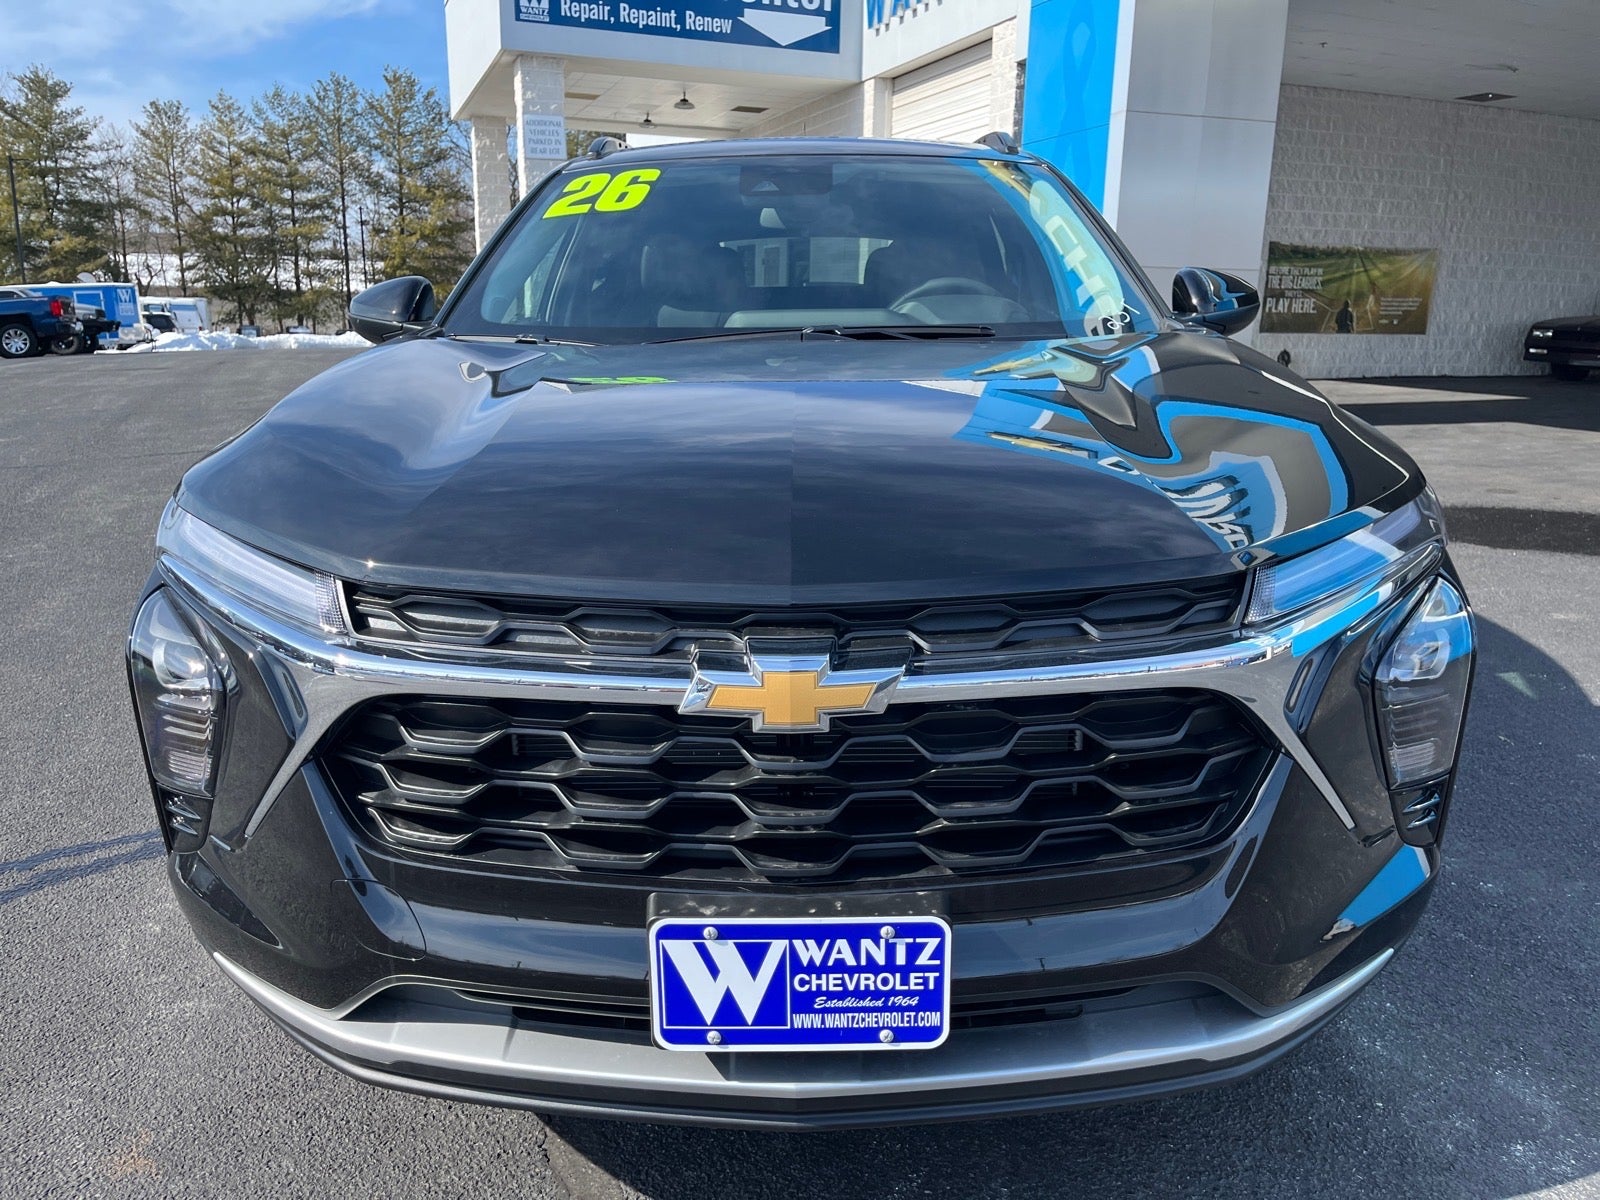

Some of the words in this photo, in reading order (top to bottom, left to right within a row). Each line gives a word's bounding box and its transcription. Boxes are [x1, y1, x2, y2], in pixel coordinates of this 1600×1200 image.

[519, 6, 549, 16] WANTZ
[560, 0, 615, 24] Repair,
[619, 2, 681, 31] Repaint,
[685, 10, 733, 34] Renew
[528, 128, 560, 137] VEHICLES
[527, 137, 553, 145] PARKED
[554, 138, 562, 146] IN
[530, 146, 548, 155] REAR
[542, 168, 662, 219] 26
[1265, 297, 1290, 314] PLAY
[661, 940, 788, 1027] W
[792, 937, 941, 967] WANTZ
[793, 972, 940, 992] CHEVROLET
[813, 996, 885, 1009] Established
[887, 995, 920, 1008] 1964
[792, 1011, 941, 1029] WWW.WANTZCHEVROLET.COM
